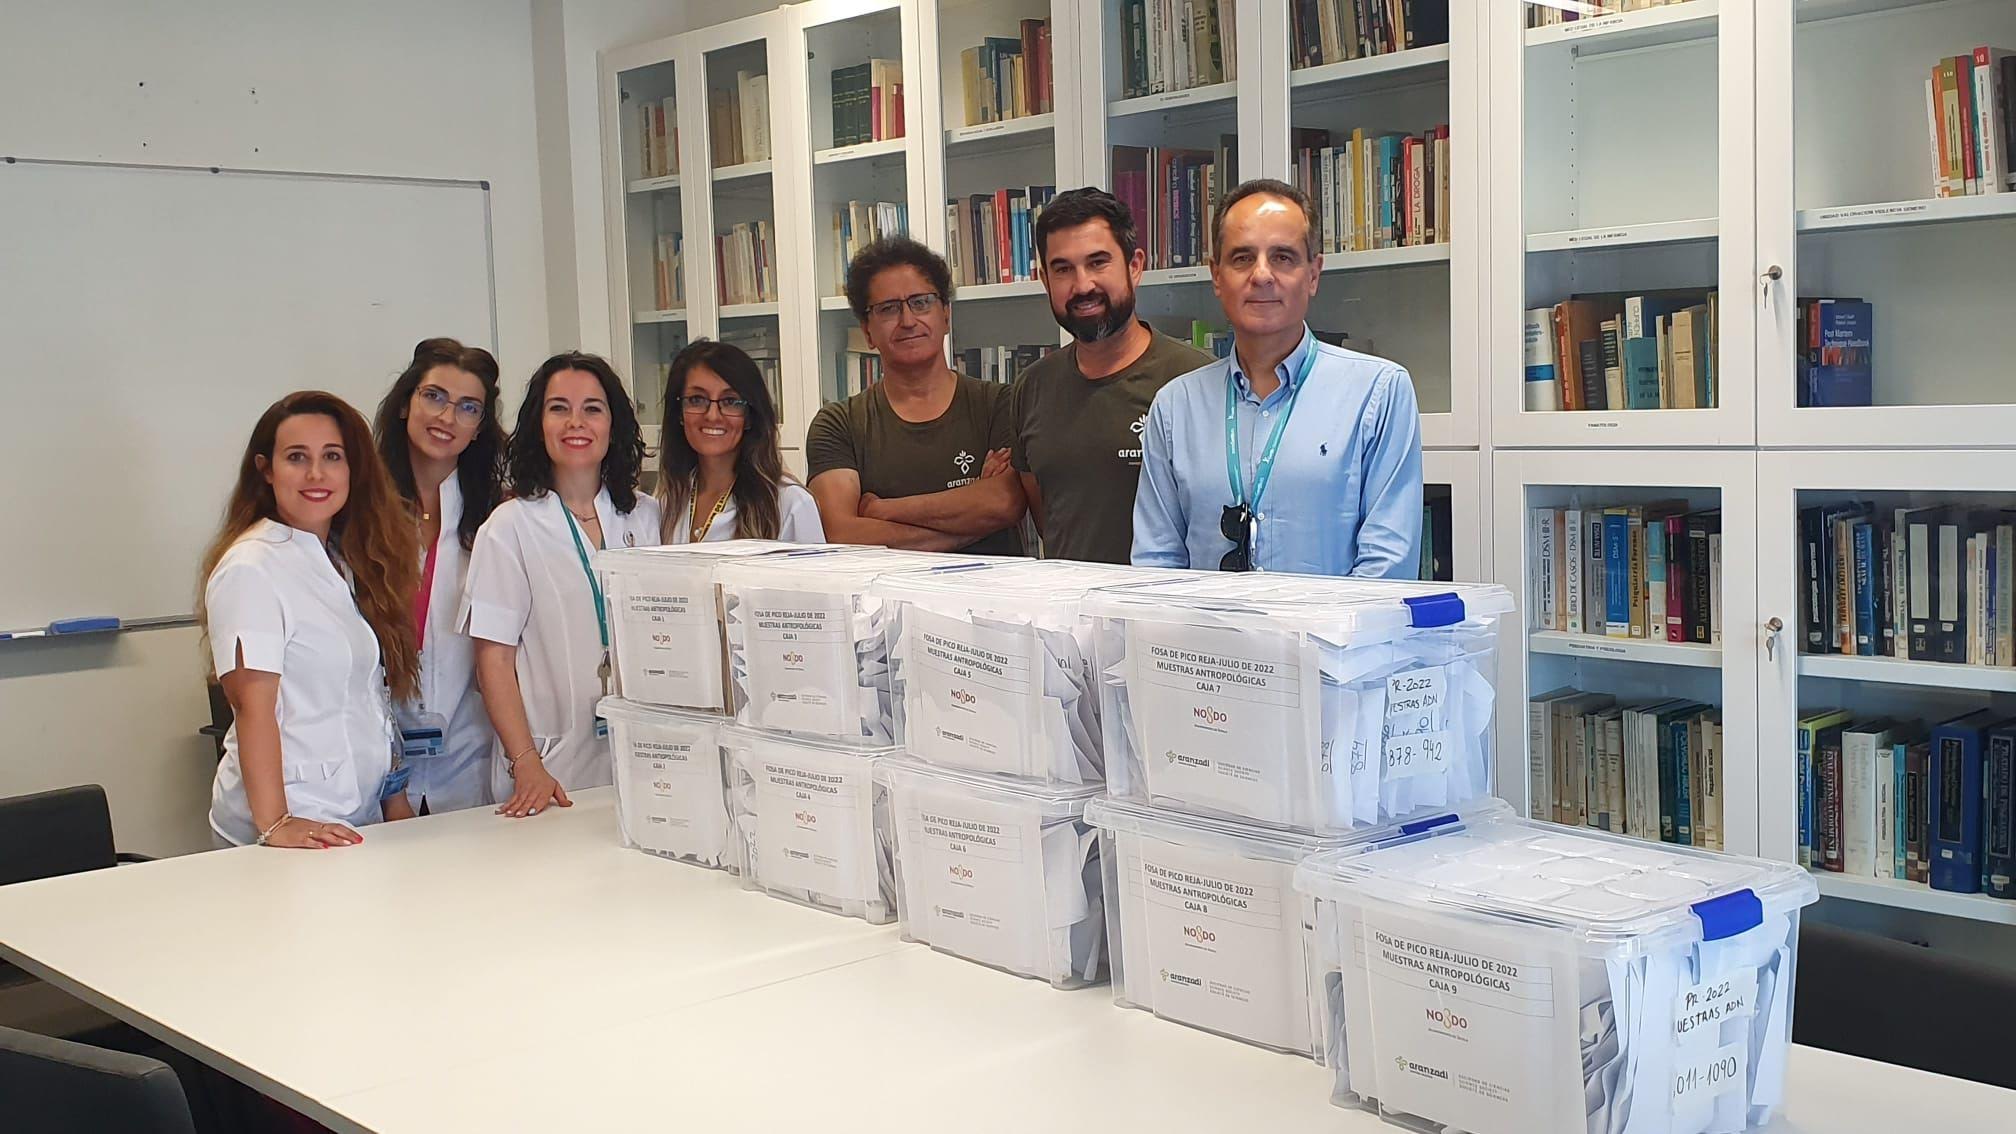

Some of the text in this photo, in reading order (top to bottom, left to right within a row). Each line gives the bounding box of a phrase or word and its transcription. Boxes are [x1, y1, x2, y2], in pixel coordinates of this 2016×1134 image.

[1414, 202, 1420, 212] LA
[1570, 584, 1576, 594] DE
[943, 640, 955, 650] PICO
[986, 651, 993, 660] DE
[994, 654, 1008, 664] 2022
[1151, 647, 1274, 673] FOSA DE PICO REJA-JULIO DE 2022
[928, 646, 1002, 675] MUESTRAS ANTROPOLÓGICAS
[953, 667, 967, 676] CAJA
[1157, 661, 1266, 686] MUESTRAS ANTROPOLÓGICAS
[1196, 682, 1214, 692] CAJA
[1423, 694, 1438, 707] ADN
[1178, 754, 1209, 767] aranzadi
[937, 817, 948, 825] PICO
[950, 843, 962, 851] CAJA
[1145, 864, 1254, 896] FOSA DE PICO REJA-JULIO DE 2022
[1150, 879, 1248, 908] MUESTRAS ANTROPOLÓGICAS
[1184, 901, 1202, 912] CAJA
[1376, 932, 1518, 977] FOSA DE PICO REJA-JULIO DE 2022
[1382, 950, 1510, 991] MUESTRAS ANTROPOLÓGICAS
[1429, 978, 1457, 994] CAJA 9
[1726, 996, 1744, 1012] ADN
[1409, 1061, 1448, 1079] aranzadi
